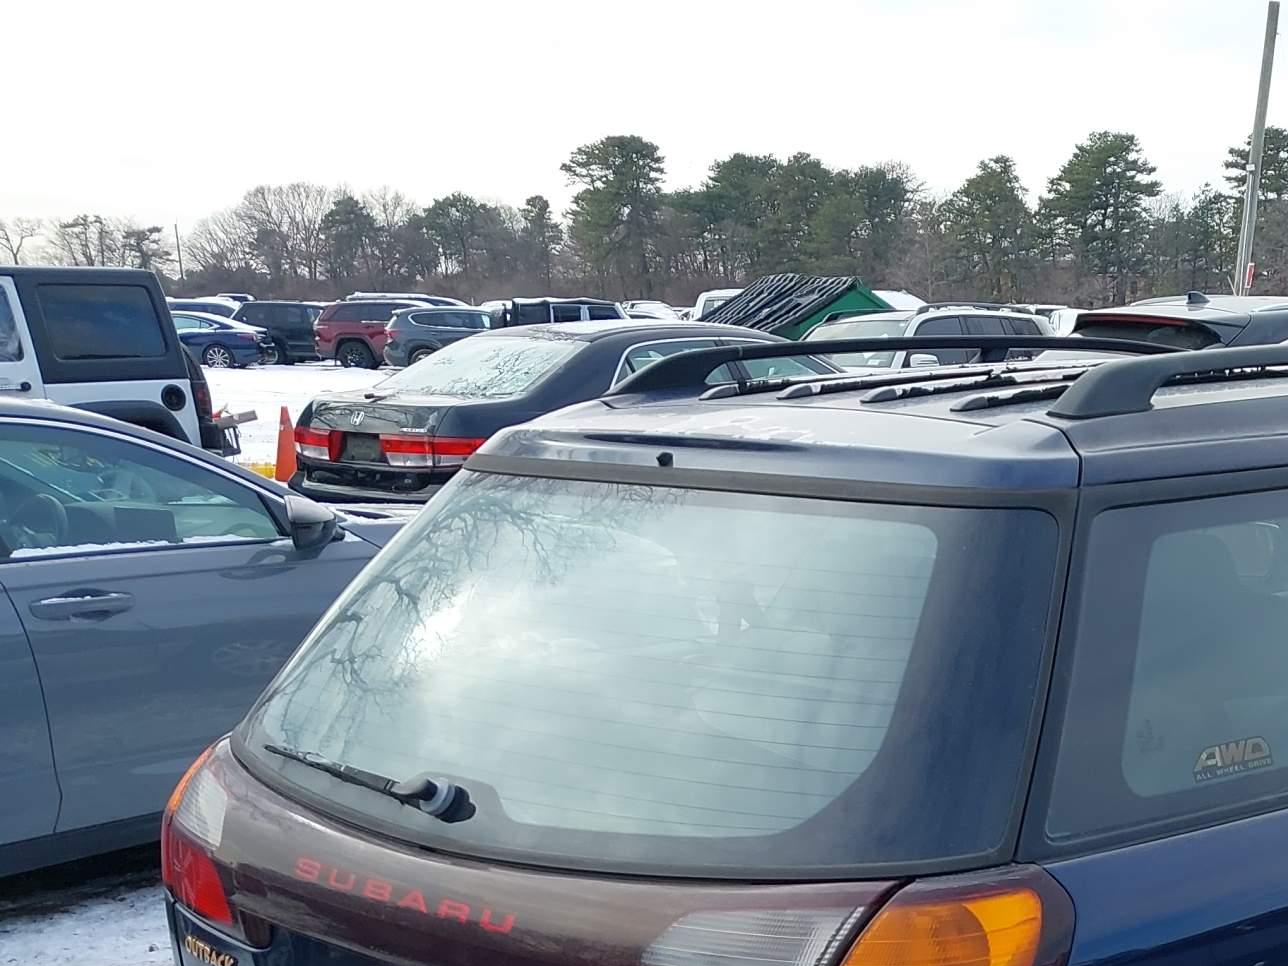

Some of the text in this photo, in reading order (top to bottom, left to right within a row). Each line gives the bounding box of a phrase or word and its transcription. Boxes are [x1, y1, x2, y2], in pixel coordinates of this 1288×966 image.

[1195, 737, 1270, 770] AWD
[1215, 764, 1246, 776] WHEEL
[1248, 758, 1272, 768] DRIVE
[295, 857, 517, 934] SUBARU
